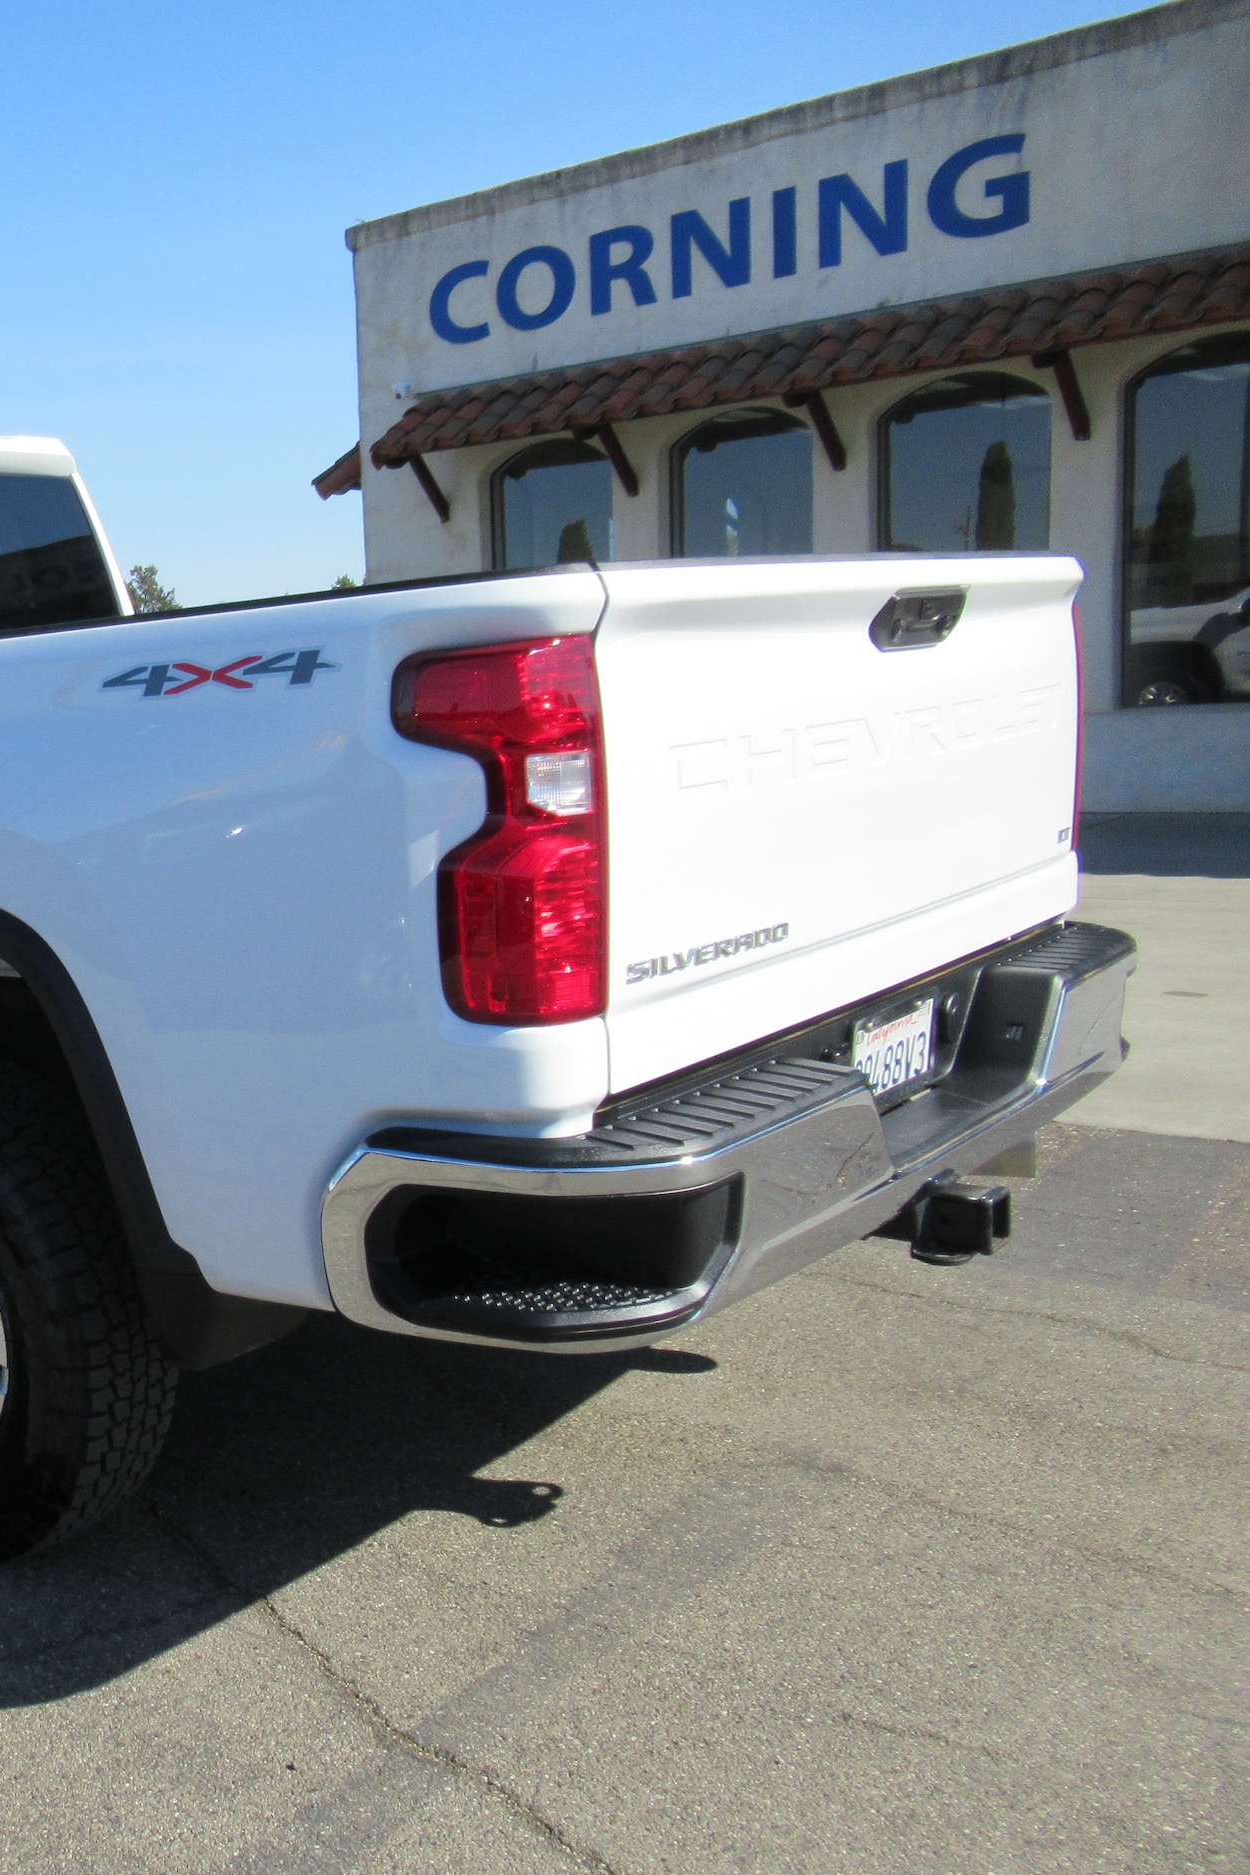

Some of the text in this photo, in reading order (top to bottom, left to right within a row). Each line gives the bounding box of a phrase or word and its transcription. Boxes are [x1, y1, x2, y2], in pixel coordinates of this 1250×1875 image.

[429, 133, 1032, 345] CORNING
[667, 682, 1066, 792] CHEVROLET
[626, 922, 789, 985] SILVERADO
